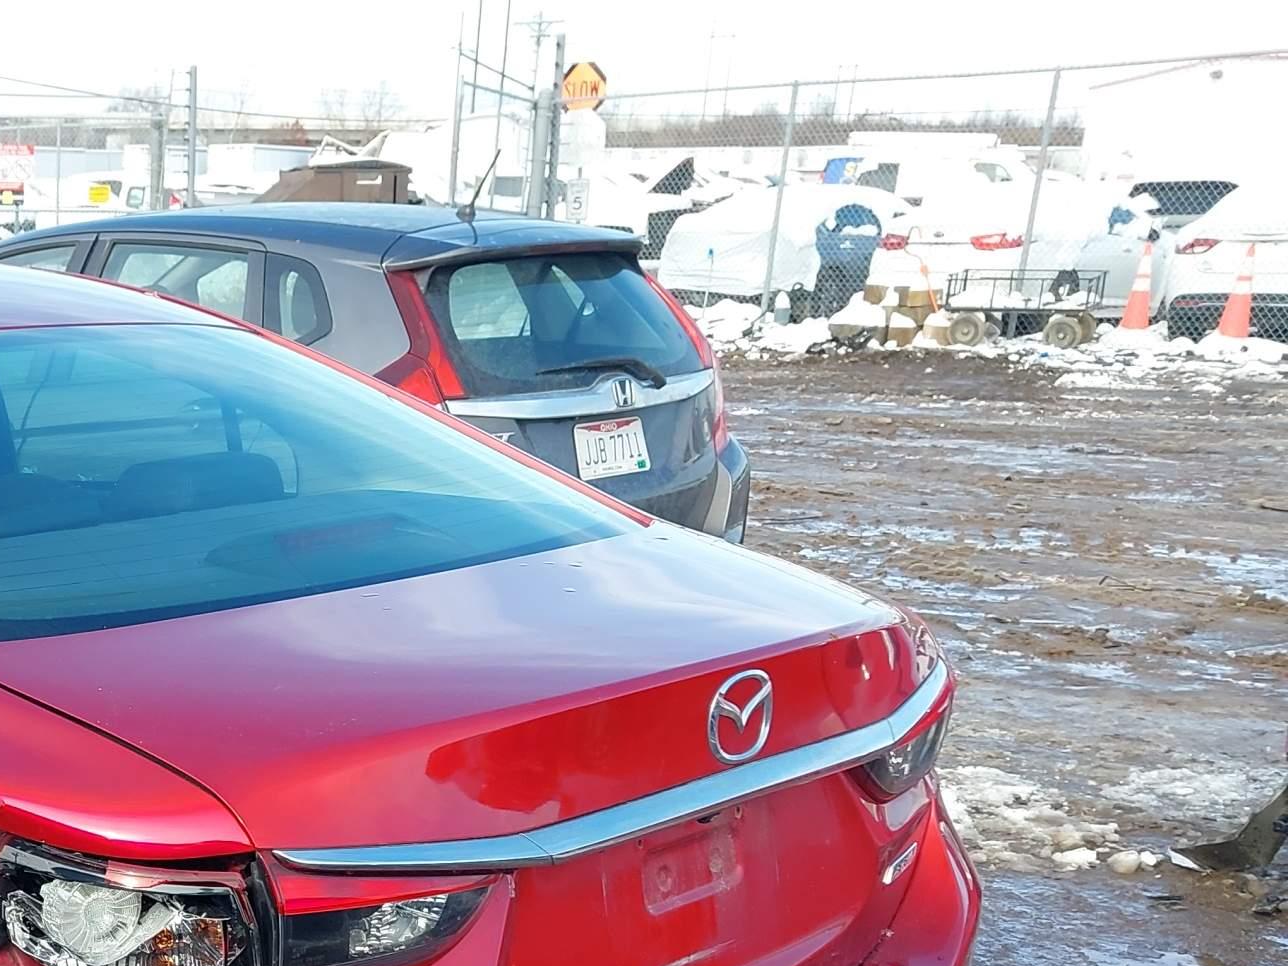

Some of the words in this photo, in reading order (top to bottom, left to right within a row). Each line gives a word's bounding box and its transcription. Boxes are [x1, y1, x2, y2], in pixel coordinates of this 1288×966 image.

[572, 195, 583, 211] 5
[599, 422, 618, 433] OHIO
[585, 437, 608, 466] JJB
[609, 432, 642, 462] 7711
